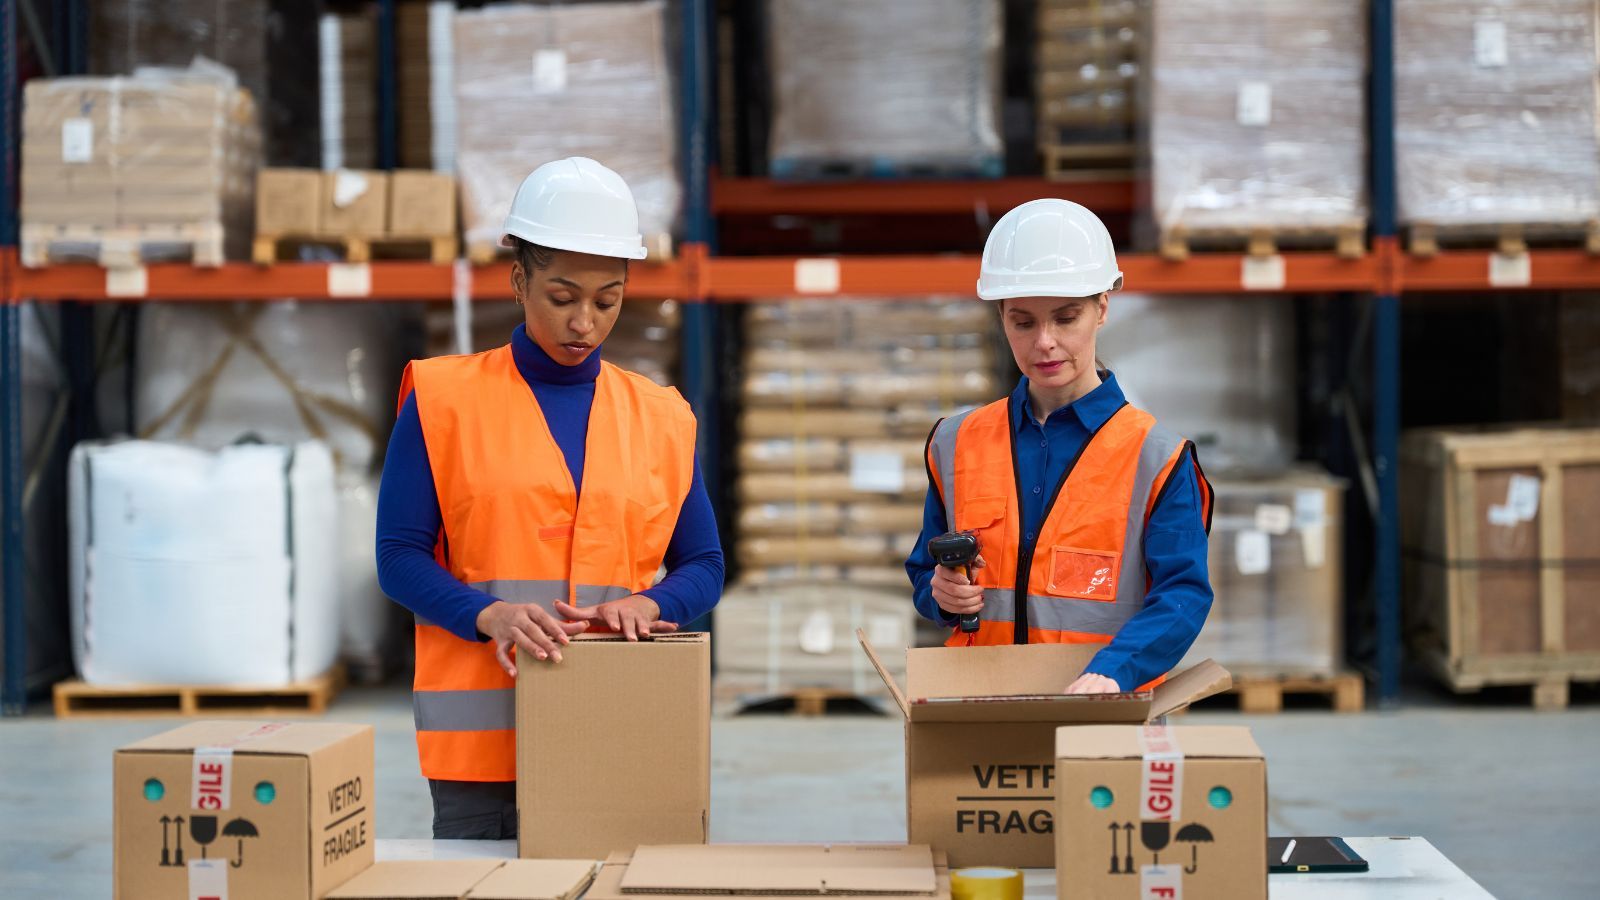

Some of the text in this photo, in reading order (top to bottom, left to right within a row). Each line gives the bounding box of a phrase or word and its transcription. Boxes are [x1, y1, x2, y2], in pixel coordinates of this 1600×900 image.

[198, 763, 222, 810] GILE
[328, 776, 361, 814] VETRO
[1148, 762, 1174, 820] GILE
[323, 820, 366, 867] FRAGILE
[956, 810, 1054, 834] FRAG
